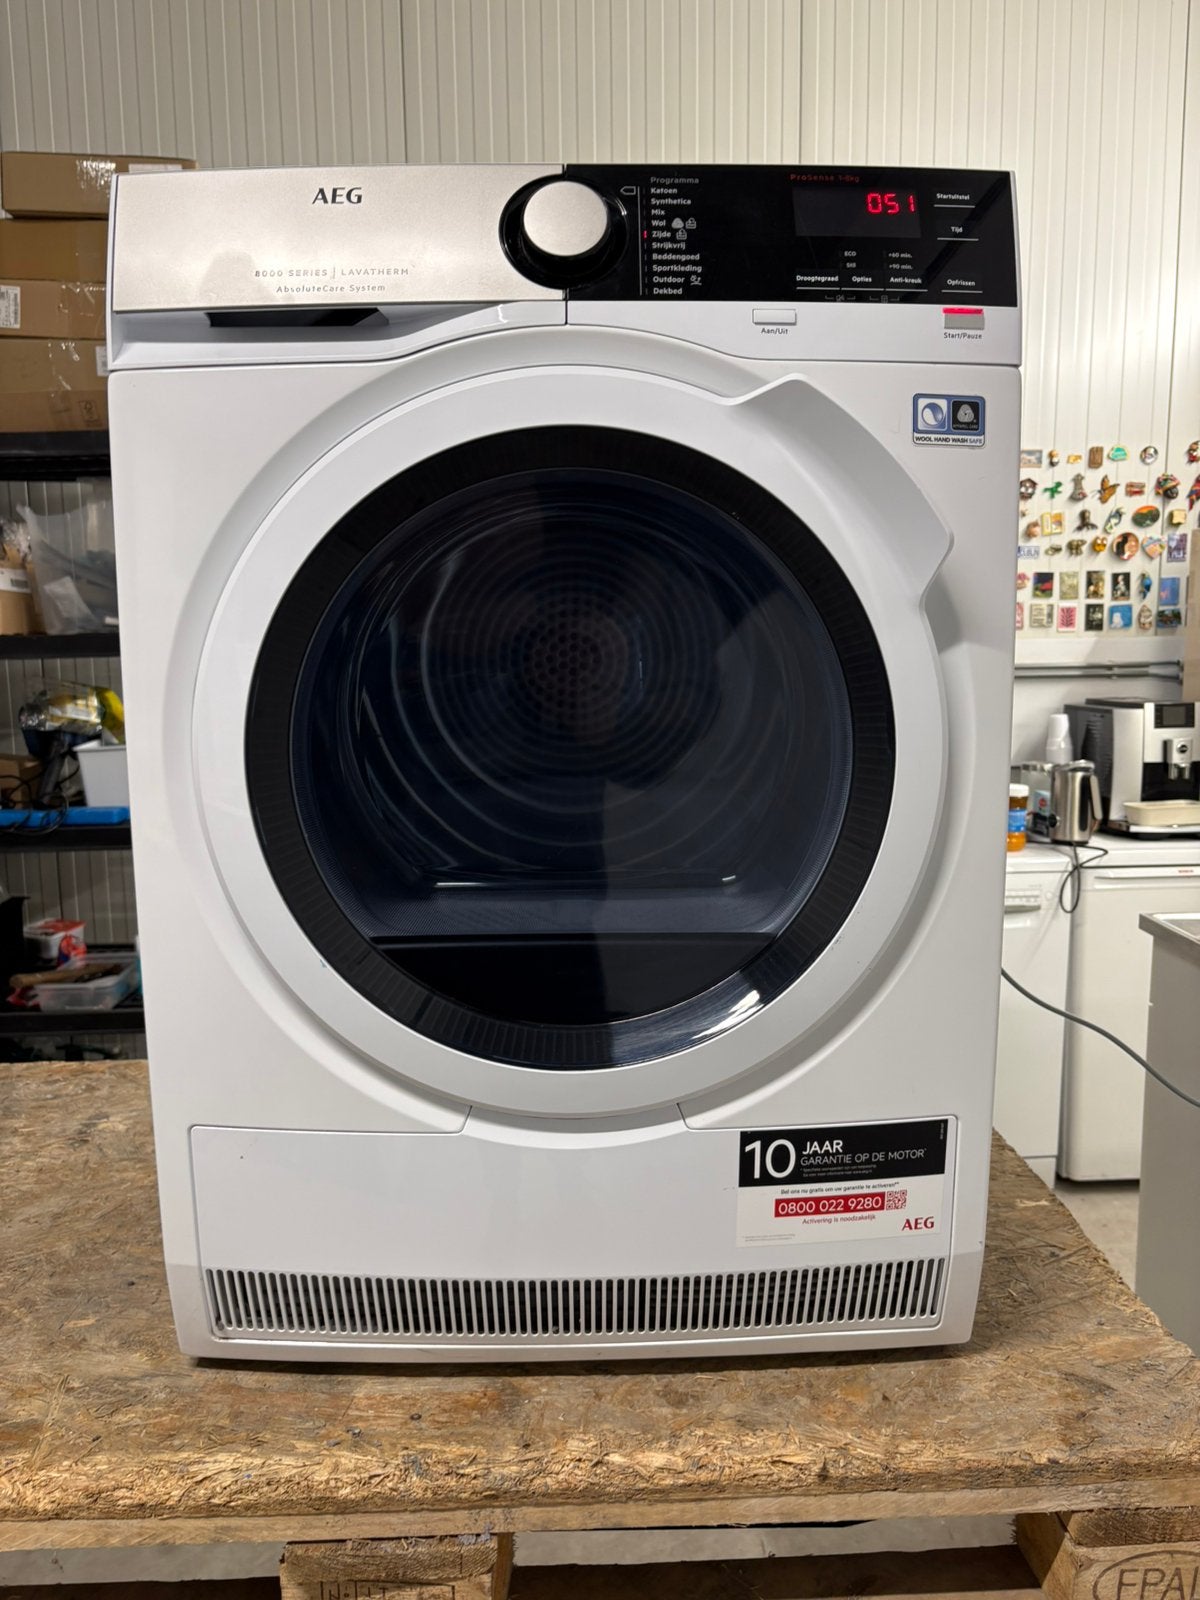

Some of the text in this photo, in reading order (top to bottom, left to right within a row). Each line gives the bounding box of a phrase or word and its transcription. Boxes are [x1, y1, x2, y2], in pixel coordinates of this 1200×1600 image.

[312, 187, 363, 204] AEG
[651, 198, 692, 206] Synthetica
[867, 193, 916, 214] 051
[652, 230, 671, 239] Zijde
[951, 226, 963, 234] Tijd
[652, 242, 686, 250] Strijkvrij
[652, 253, 700, 261] Beddengoed
[288, 269, 328, 277] SERIES
[341, 268, 409, 276] LAVATHERM
[652, 264, 702, 273] Sportkleding
[276, 284, 386, 293] AbsoluteCare System
[653, 287, 683, 295] Dekbed
[761, 327, 789, 335] Aan/Uit
[943, 332, 982, 340] Start/Pauze
[802, 1140, 843, 1155] JAAR
[745, 1139, 796, 1179] 10
[800, 1154, 852, 1166] GARANTIE
[854, 1153, 870, 1163] OP
[872, 1152, 885, 1162] DE
[778, 1196, 882, 1215] 0800 022 9280
[802, 1215, 832, 1225] Activering
[840, 1214, 876, 1222] noodzakelijk
[902, 1216, 935, 1231] AEG
